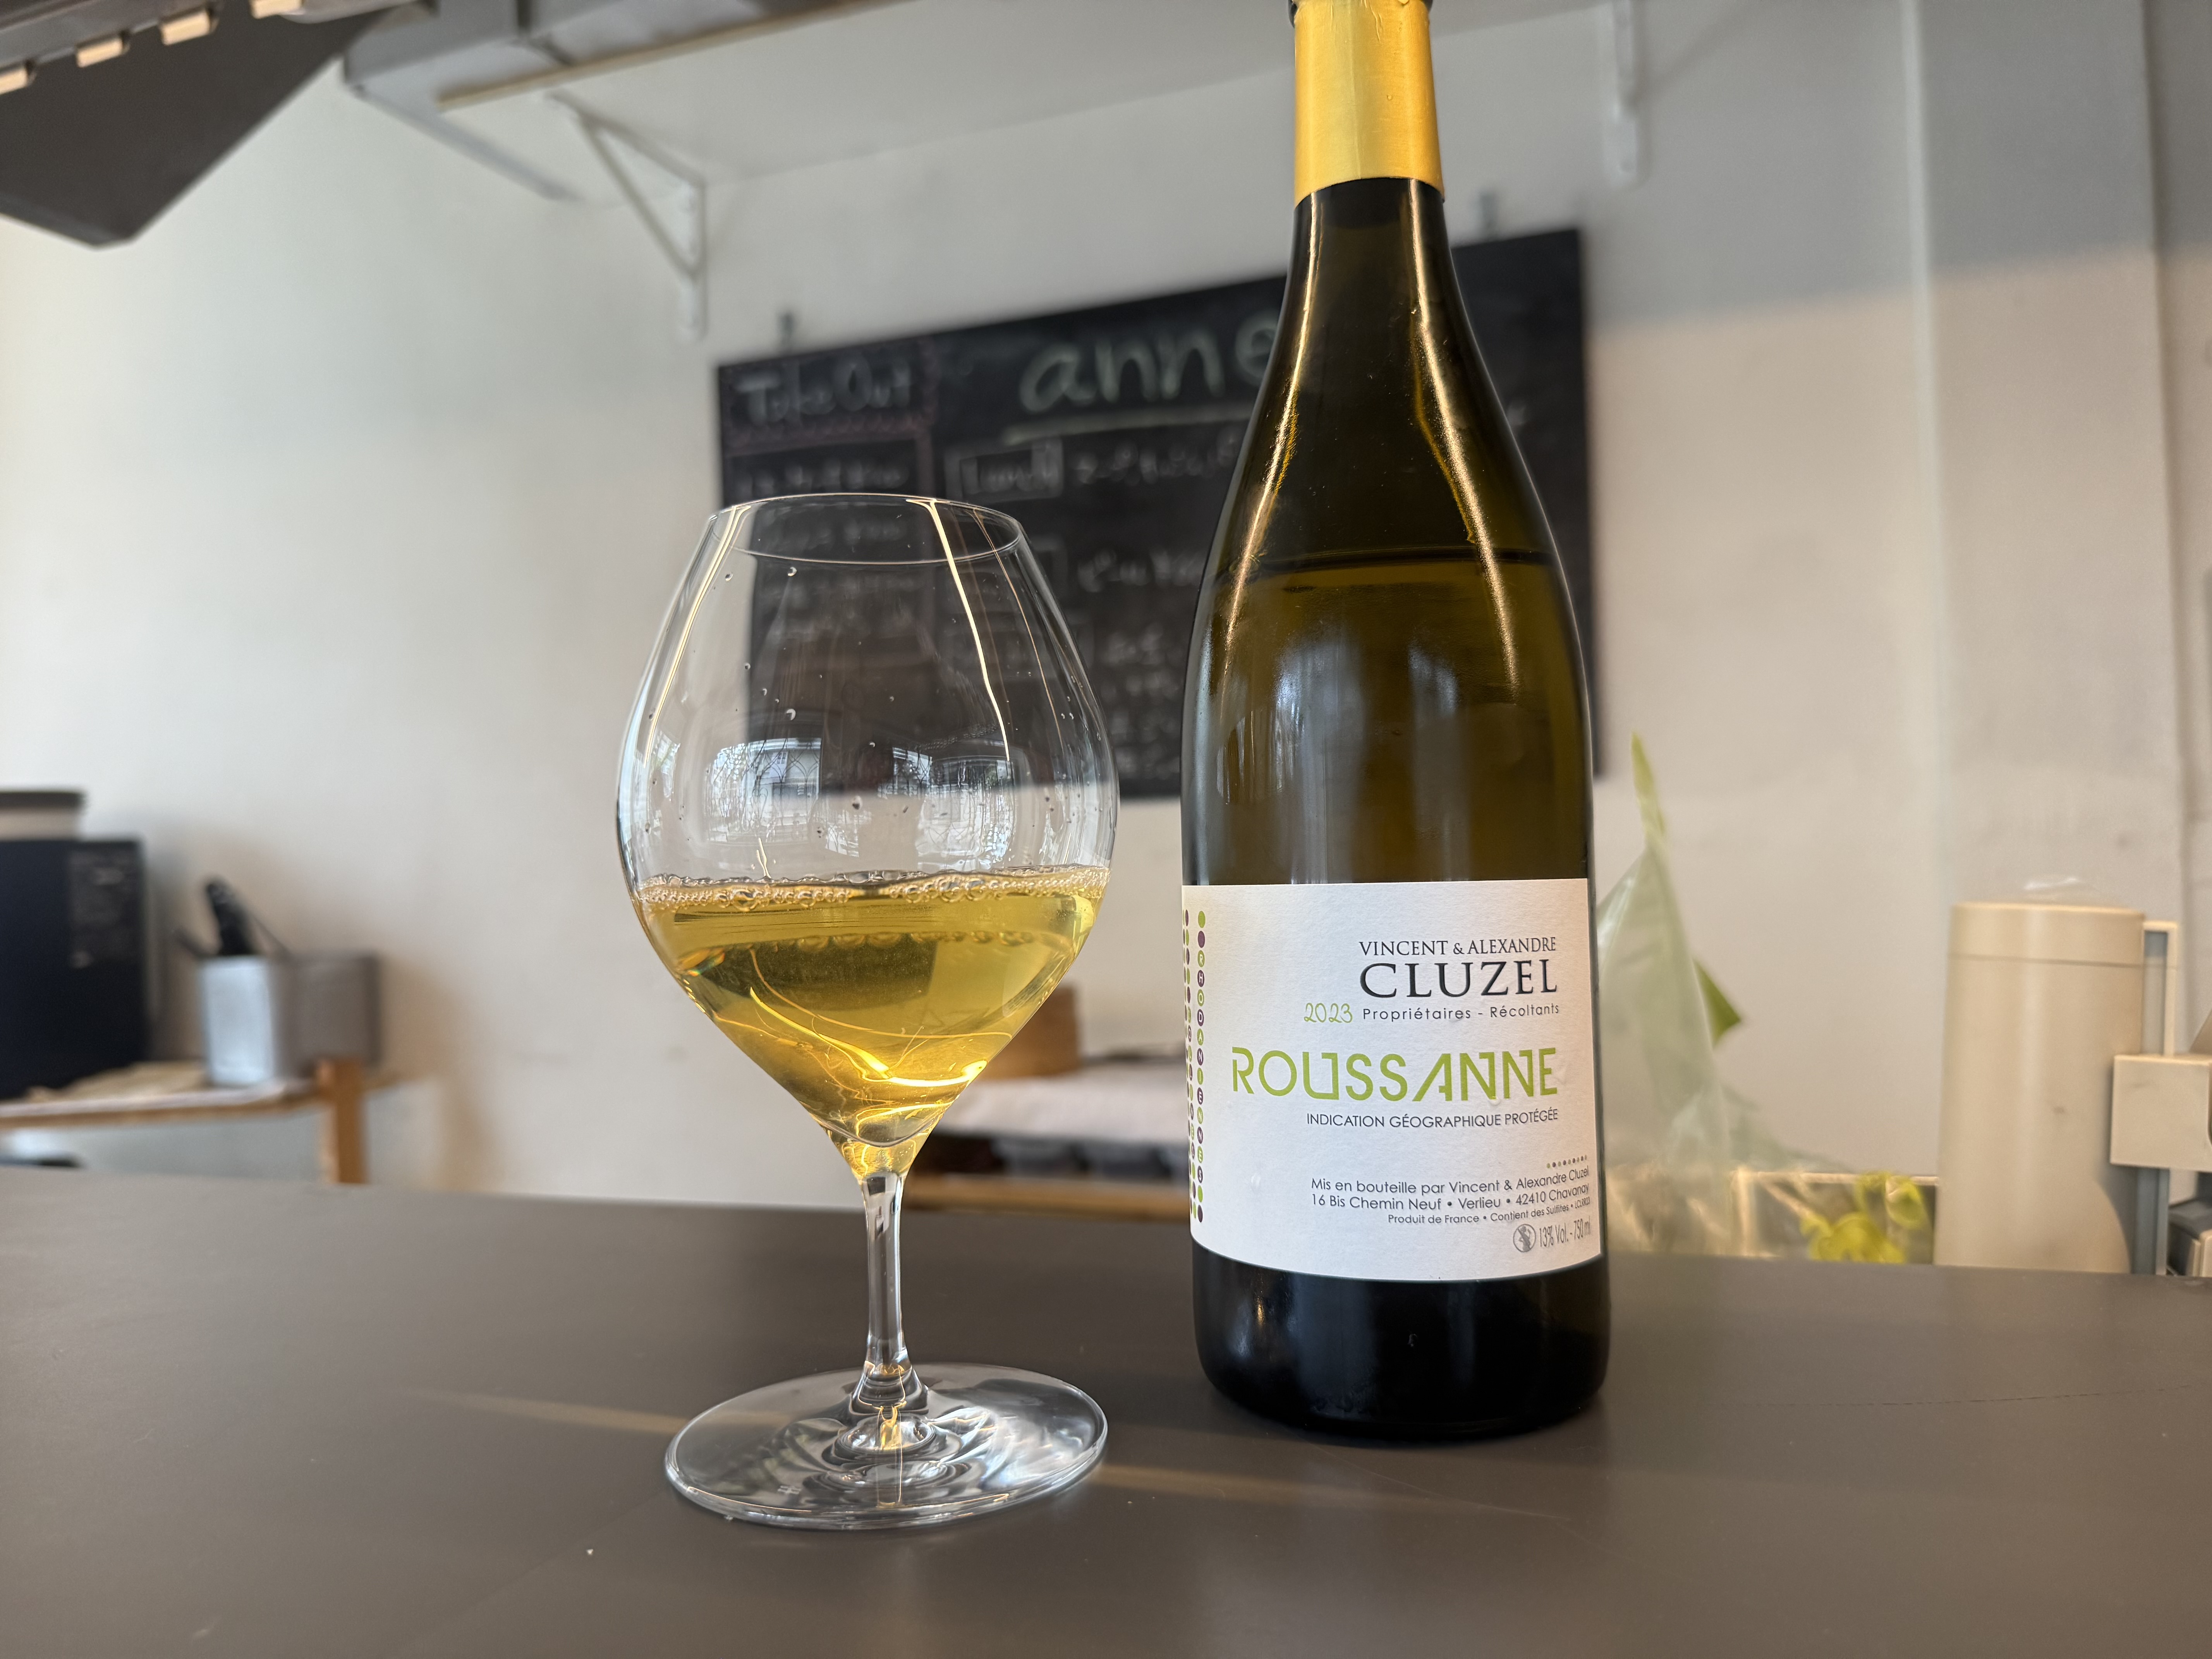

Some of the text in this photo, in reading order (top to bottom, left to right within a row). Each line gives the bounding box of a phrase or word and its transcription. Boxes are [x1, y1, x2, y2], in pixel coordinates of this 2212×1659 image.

[1359, 937, 1556, 955] VINCENT & ALEXANDRE
[1360, 959, 1557, 998] CLUZEL
[1304, 1002, 1353, 1024] 2023
[1363, 1007, 1470, 1022] Propriétaires
[1491, 1003, 1559, 1018] Récoltants
[1232, 1046, 1557, 1102] ROUSSANNE
[1307, 1108, 1558, 1128] INDICATION GÉOGRAPHIQUE PROTÉGÉE
[1311, 1165, 1589, 1196] Mis en bouteille par Vincent & Alexandre Cluzel
[1312, 1183, 1589, 1210] 16 Bis Chemin Neuf Verlieu 42410 Chavanay
[1388, 1214, 1425, 1224] Produit
[1428, 1214, 1441, 1224] de
[1445, 1214, 1479, 1224] France
[1490, 1209, 1528, 1222] Contient
[1531, 1209, 1544, 1217] des
[1546, 1204, 1569, 1215] Sulfites
[1539, 1225, 1554, 1247] 13%
[1555, 1223, 1569, 1244] Vol.
[1573, 1218, 1583, 1240] 750
[1584, 1215, 1591, 1236] ml
